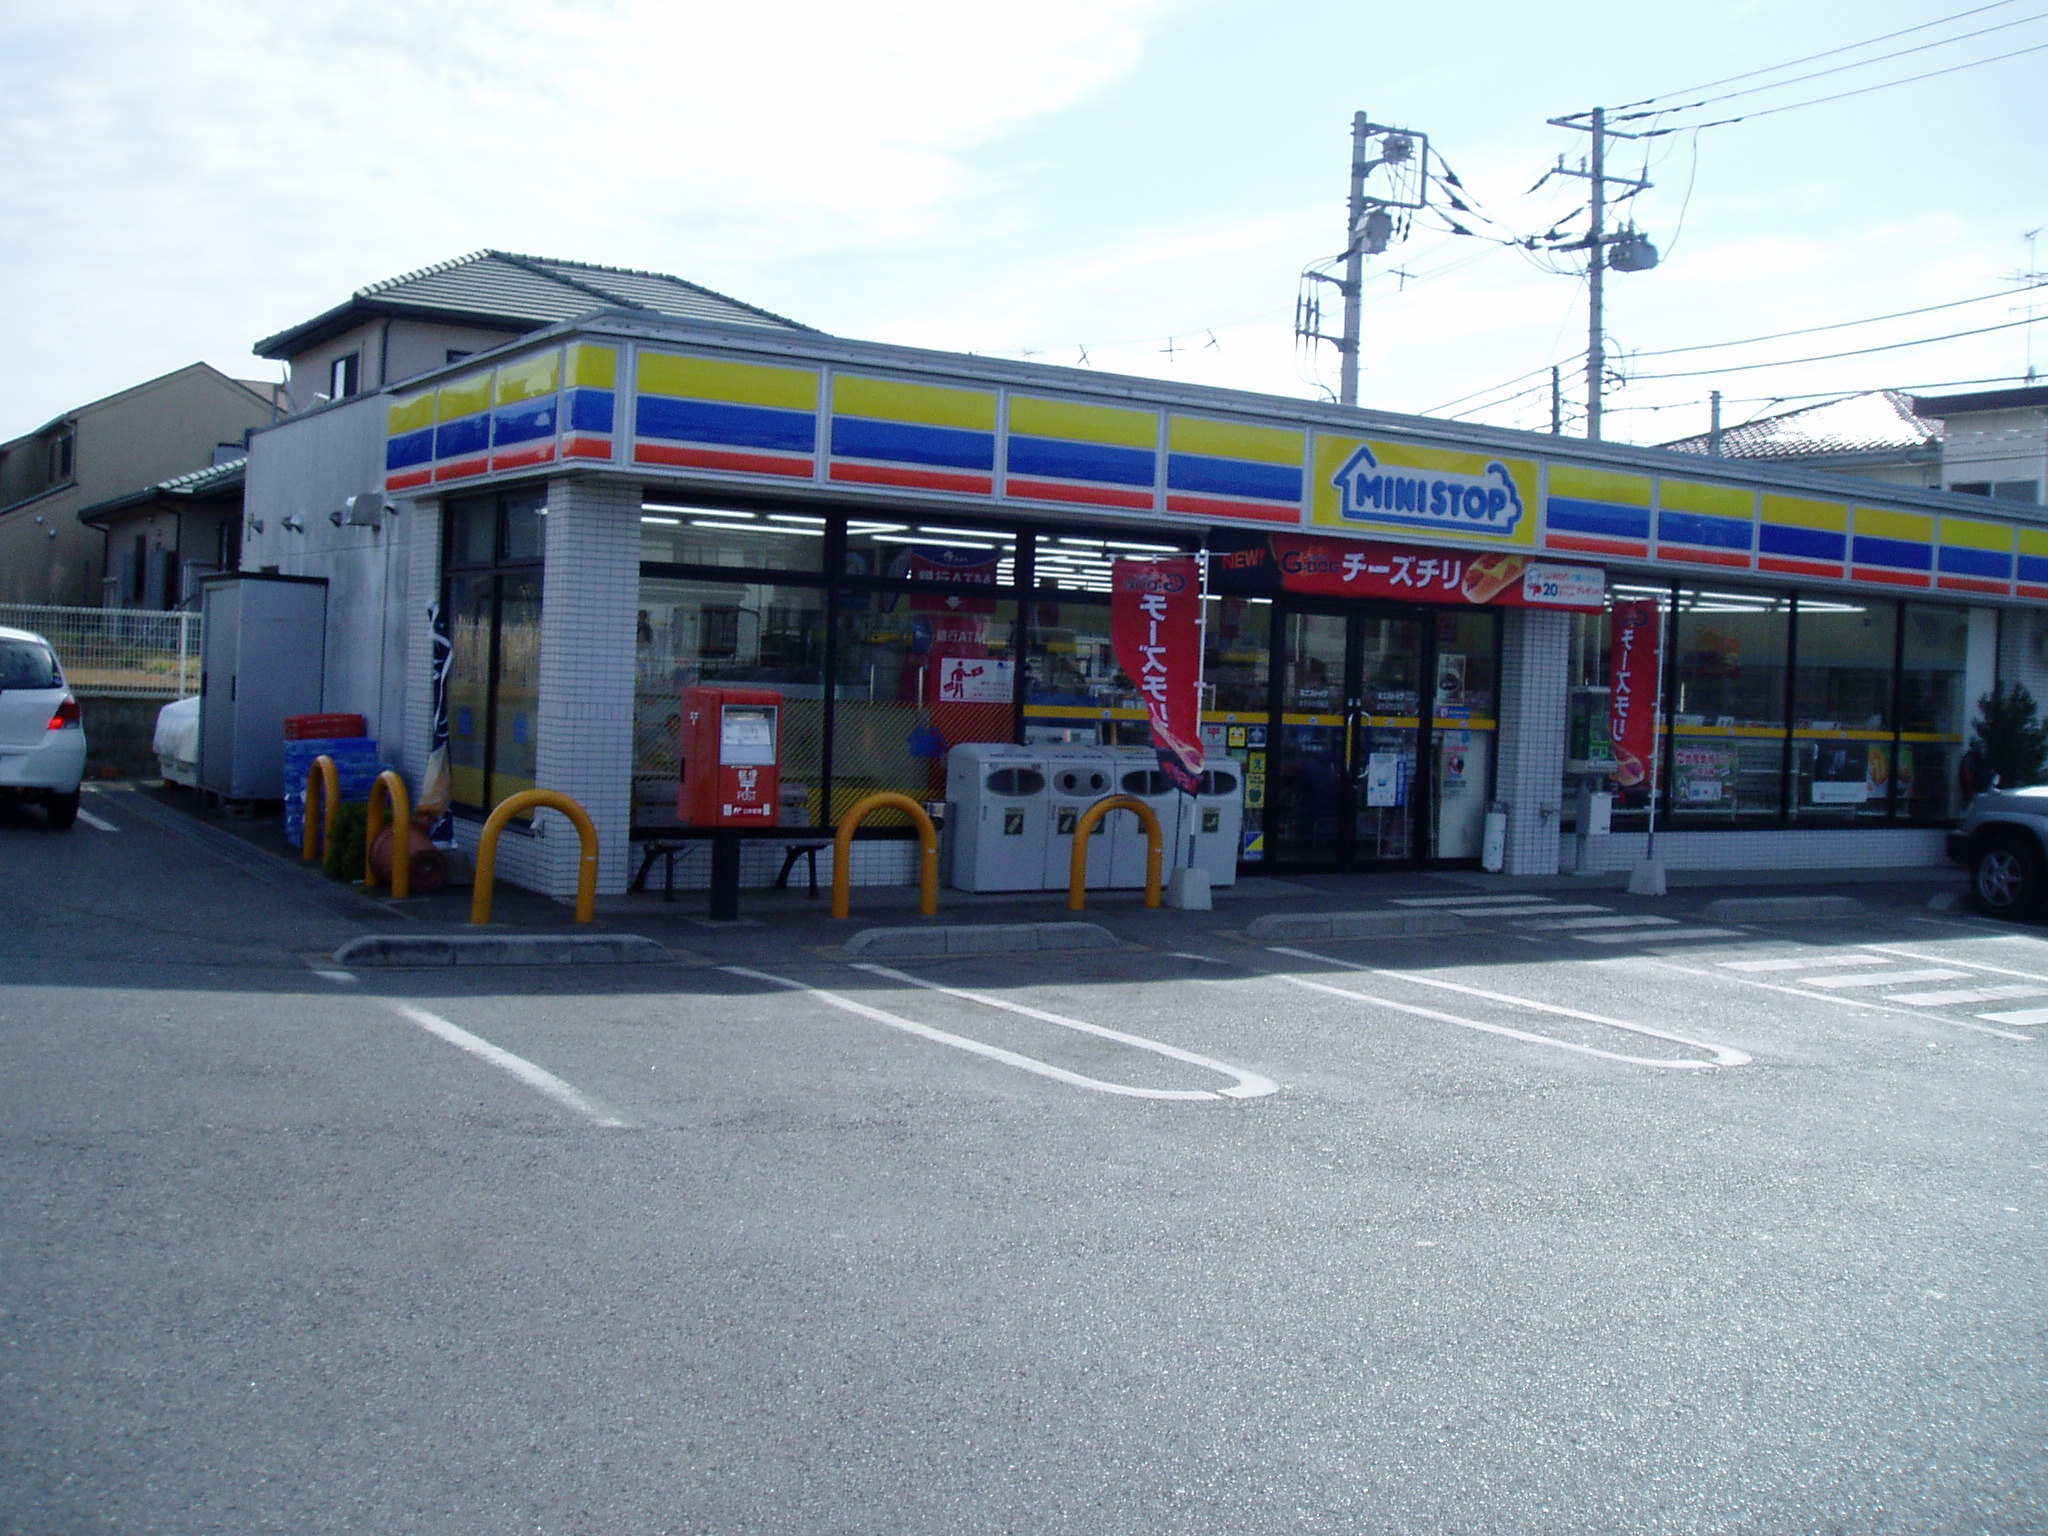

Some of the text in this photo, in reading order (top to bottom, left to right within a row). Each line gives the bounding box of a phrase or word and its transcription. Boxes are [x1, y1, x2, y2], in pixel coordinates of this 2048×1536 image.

[1356, 472, 1507, 521] MINISTOP
[1342, 552, 1461, 589] チーズチリ
[737, 791, 757, 801] POST
